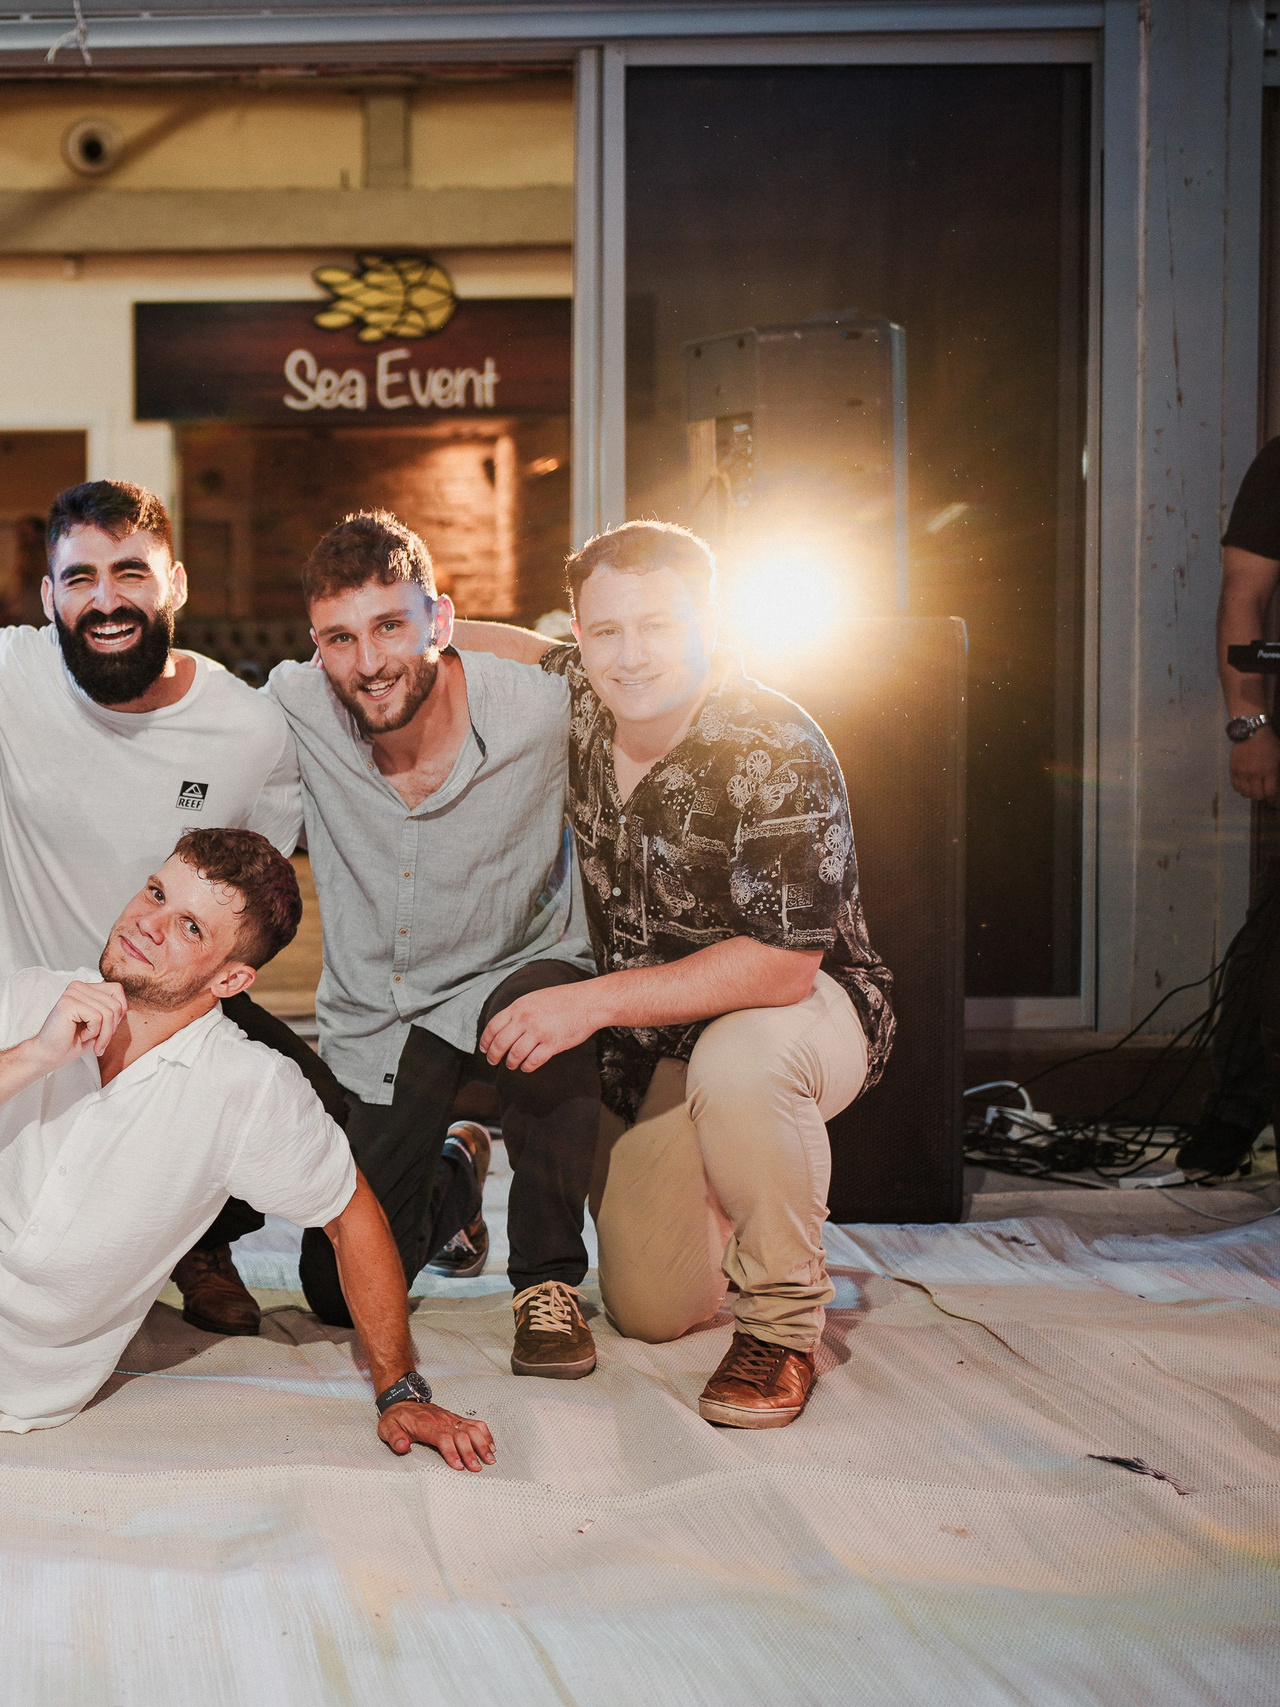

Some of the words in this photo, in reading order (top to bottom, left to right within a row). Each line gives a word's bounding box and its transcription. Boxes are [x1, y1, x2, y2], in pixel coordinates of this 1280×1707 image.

[282, 349, 368, 410] Sea
[376, 348, 500, 409] Event
[178, 798, 202, 809] REEF
